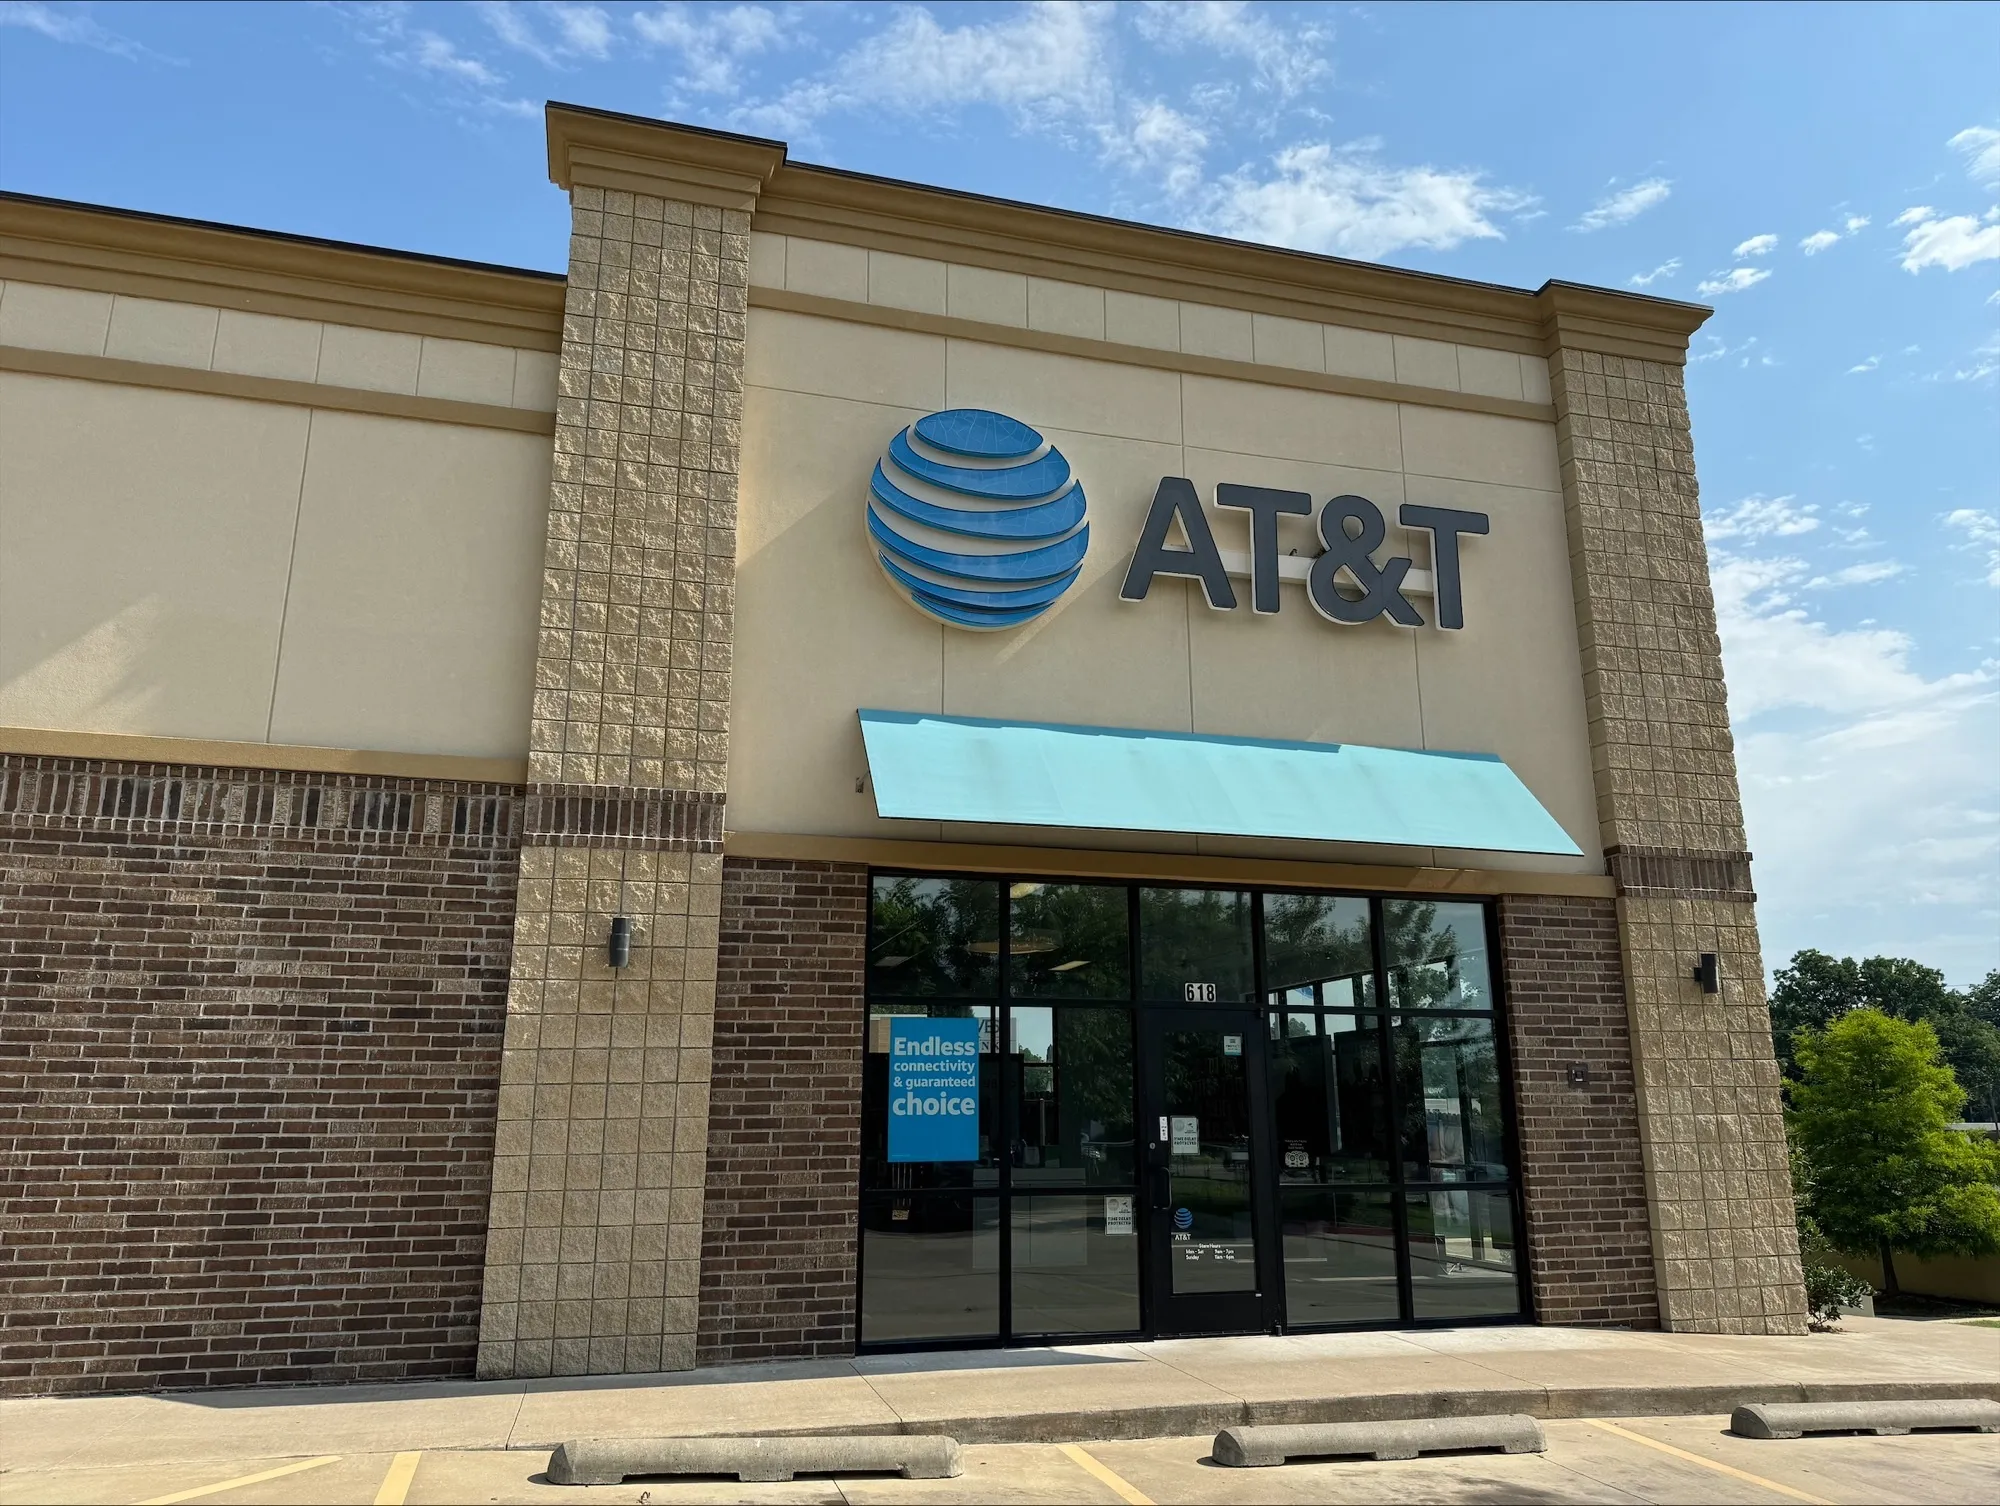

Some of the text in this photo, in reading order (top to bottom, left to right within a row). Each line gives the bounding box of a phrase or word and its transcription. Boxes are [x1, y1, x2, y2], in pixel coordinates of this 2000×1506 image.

[1118, 476, 1491, 632] AT&T
[1186, 984, 1215, 1002] 618
[894, 1036, 976, 1056] Endless
[894, 1060, 976, 1074] connectivity
[893, 1076, 976, 1090] & guaranteed
[892, 1091, 976, 1116] choice
